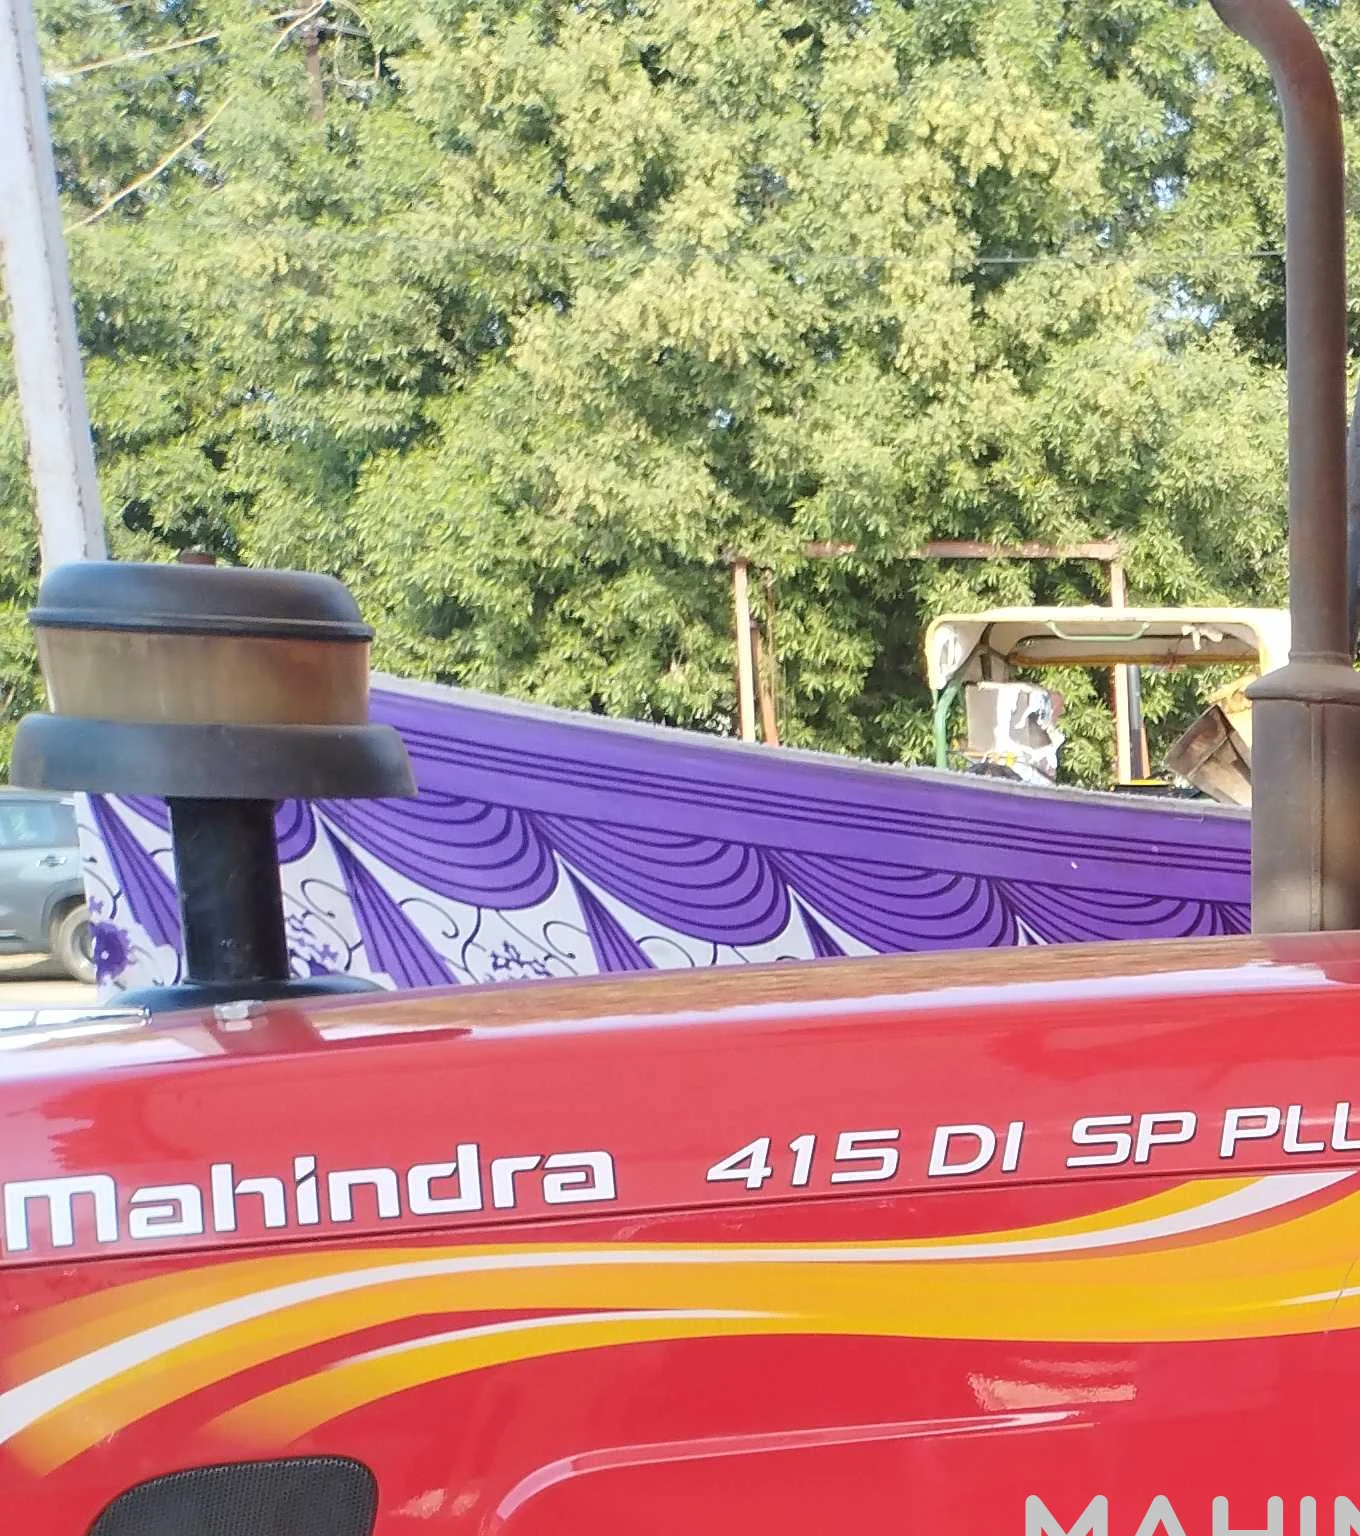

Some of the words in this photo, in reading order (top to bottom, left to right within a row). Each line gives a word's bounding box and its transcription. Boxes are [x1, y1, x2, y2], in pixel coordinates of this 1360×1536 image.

[706, 1127, 902, 1190] 415
[927, 1121, 1026, 1180] DI
[1065, 1110, 1198, 1169] SP
[3, 1143, 618, 1252] Mahindra
